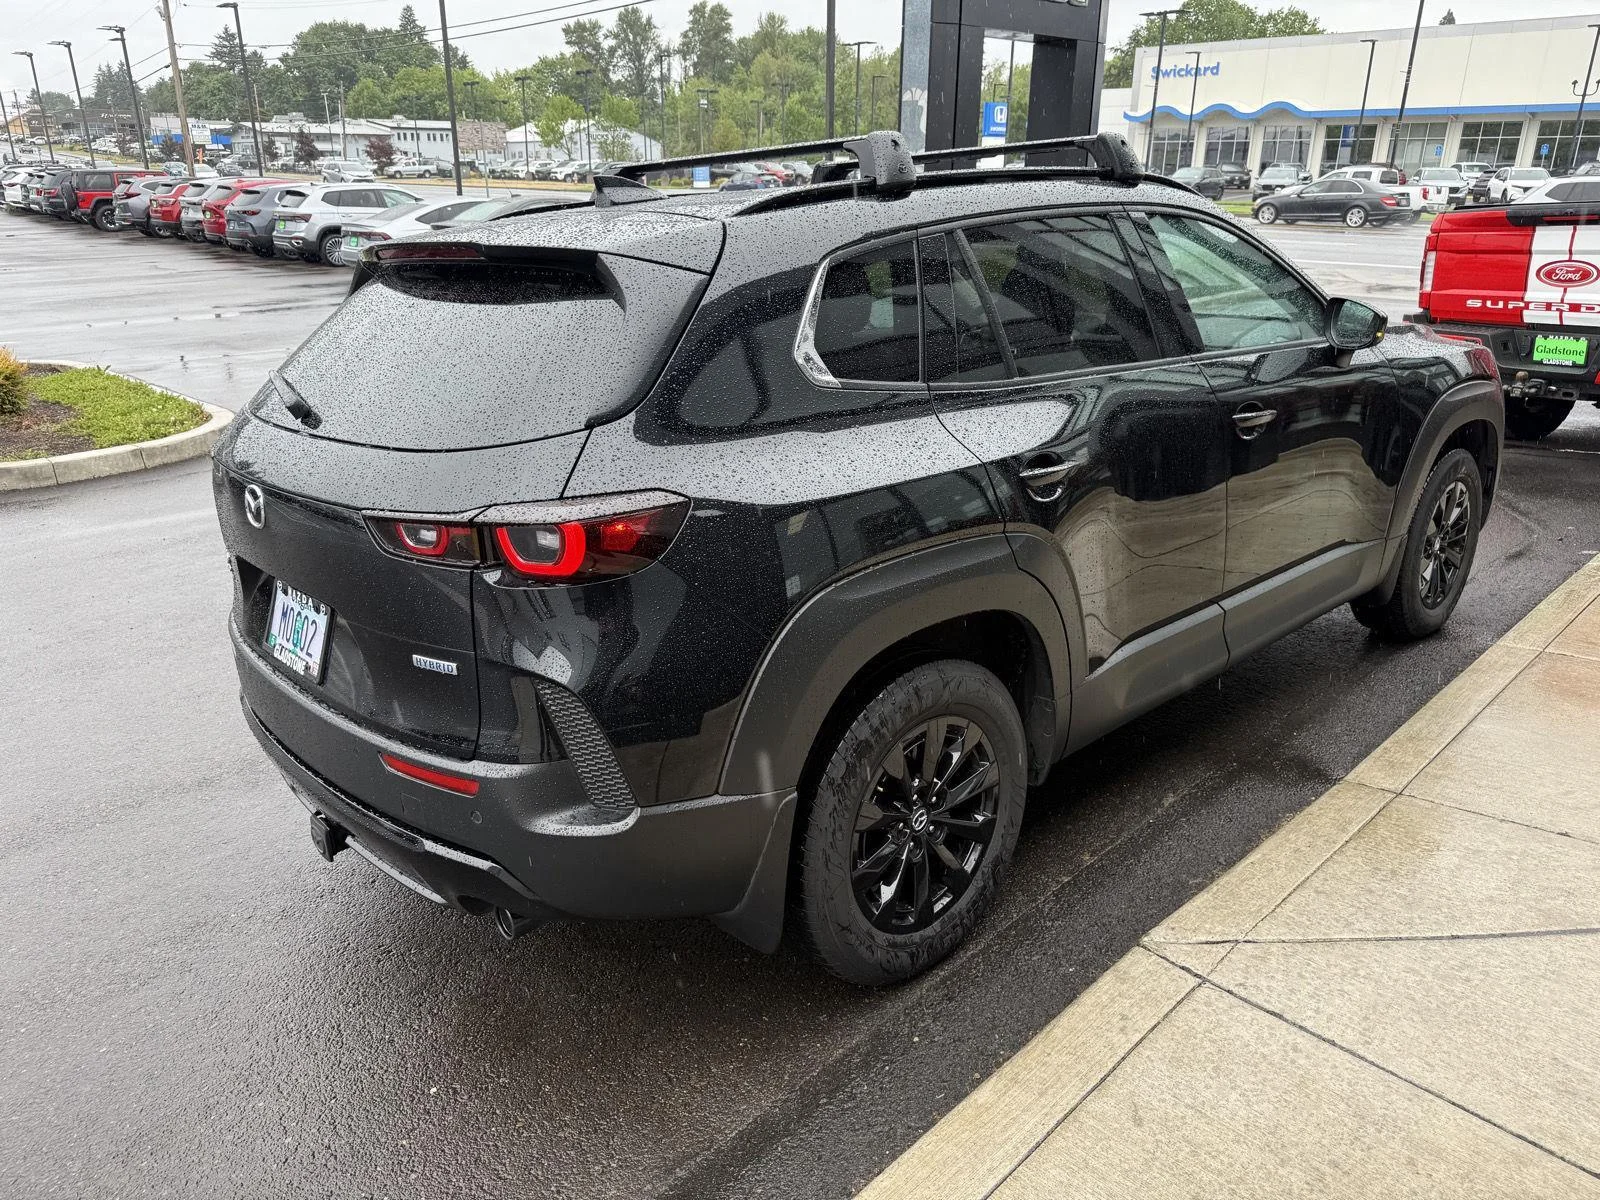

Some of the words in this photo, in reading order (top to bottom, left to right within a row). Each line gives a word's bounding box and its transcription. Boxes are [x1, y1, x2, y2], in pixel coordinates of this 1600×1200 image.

[1151, 61, 1220, 80] Swickard
[1551, 266, 1582, 281] Ford
[1466, 299, 1570, 312] SUPER
[1535, 345, 1585, 357] Gladstone
[273, 644, 307, 676] GLADSTONE
[415, 656, 454, 673] HYBRID
